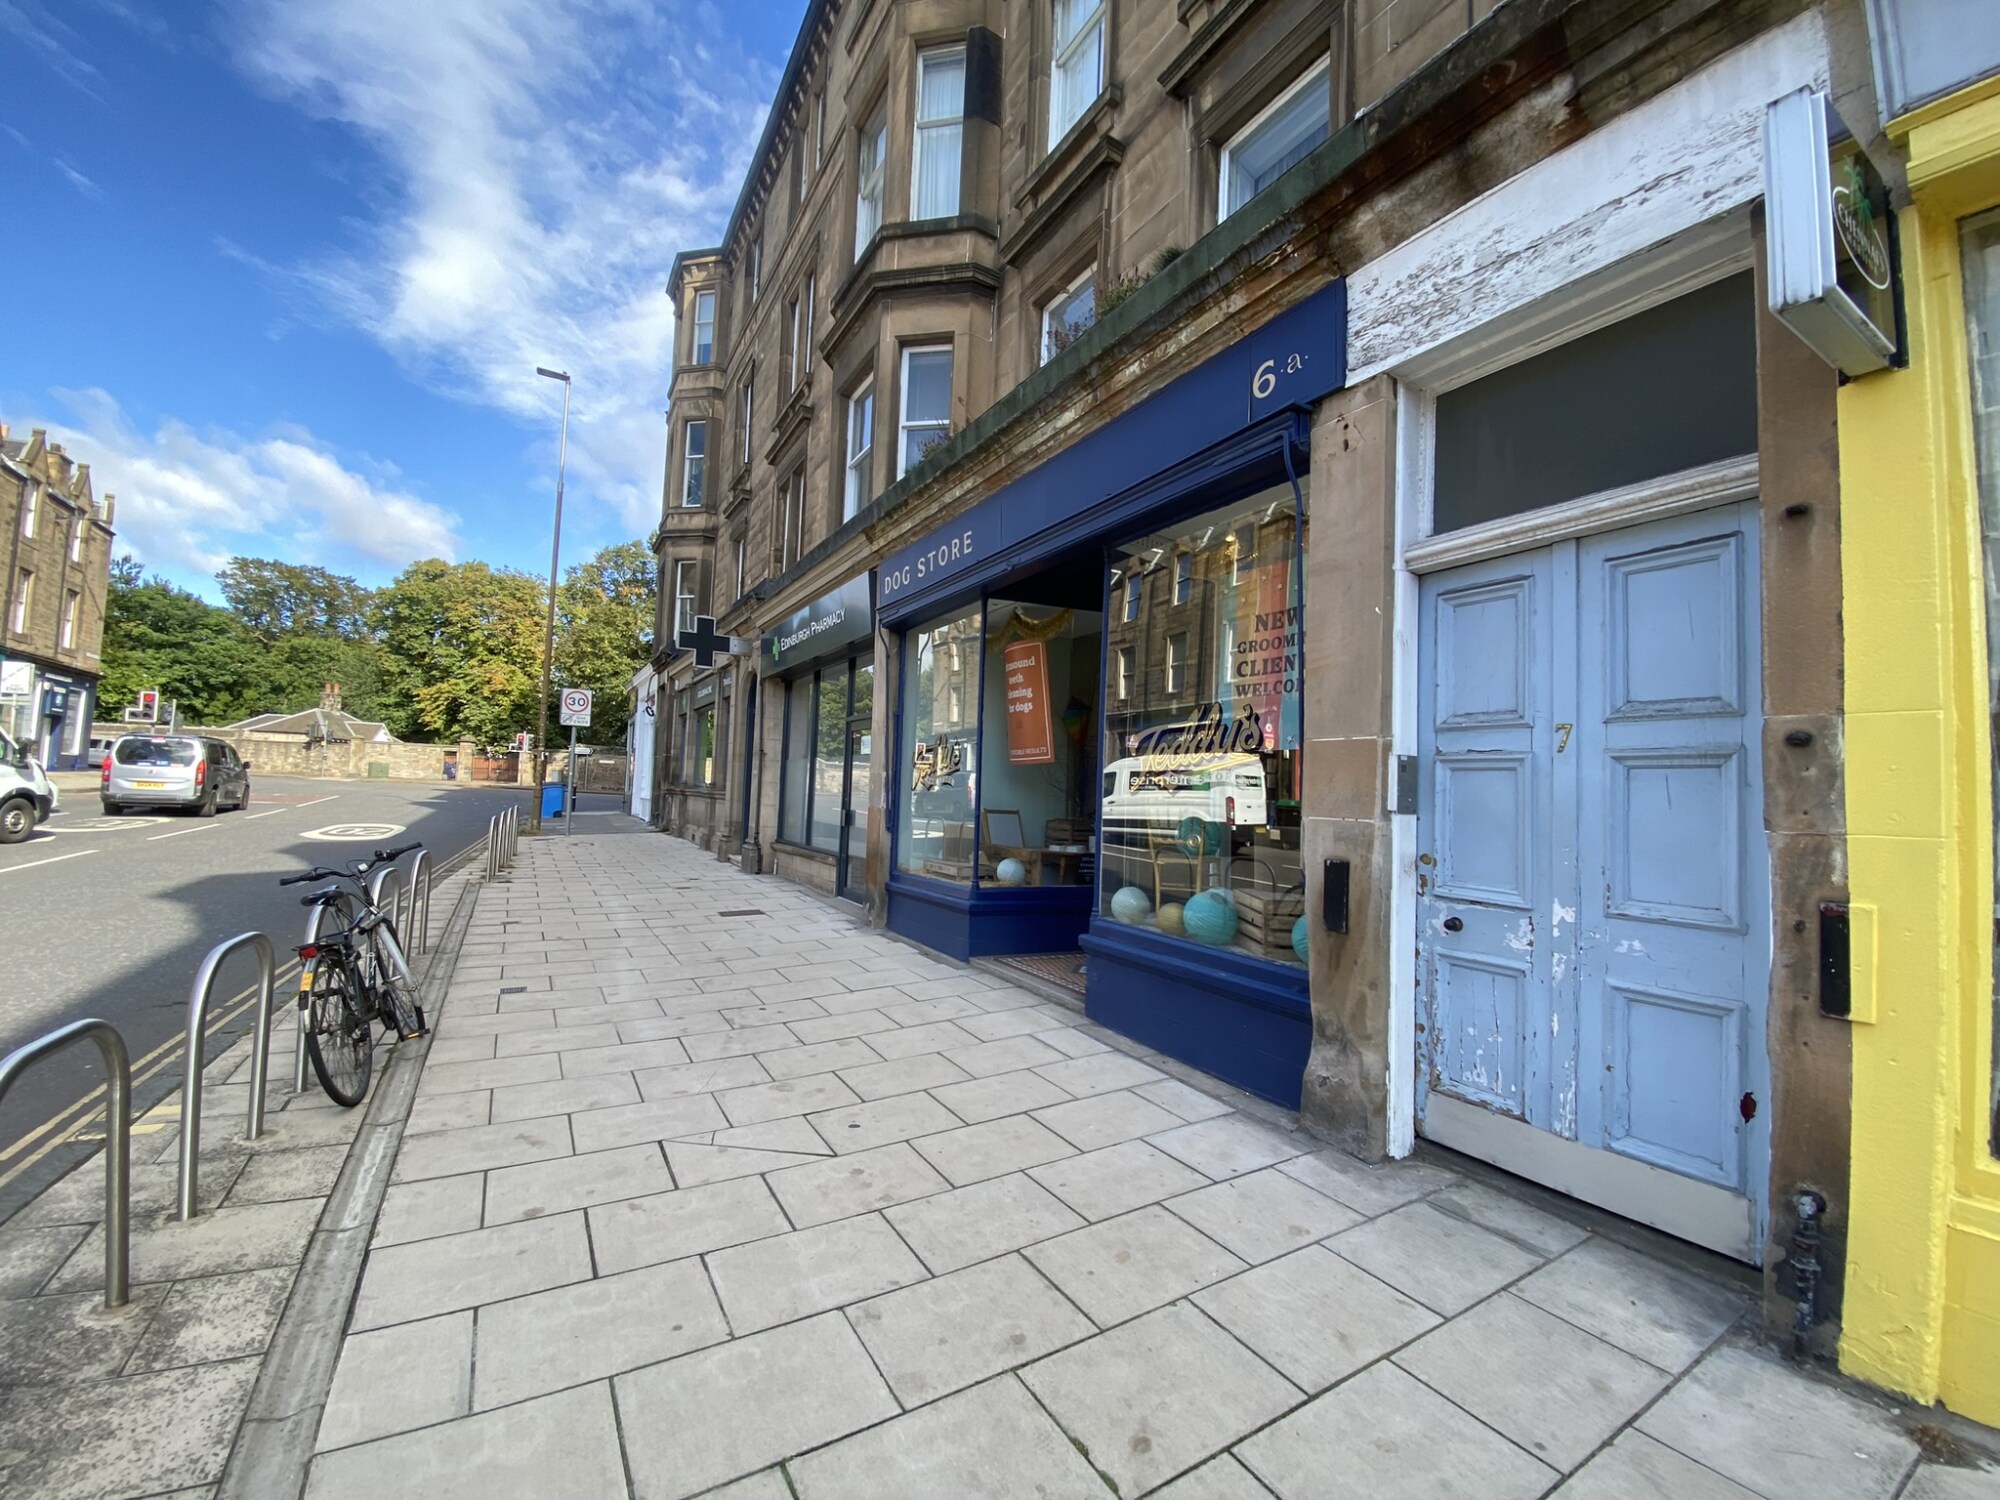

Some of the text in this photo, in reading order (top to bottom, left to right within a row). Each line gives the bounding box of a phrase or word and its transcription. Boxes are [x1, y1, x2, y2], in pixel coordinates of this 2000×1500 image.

[885, 531, 973, 594] DOG STORE
[1236, 654, 1297, 678] CLIEN
[568, 697, 586, 707] 30
[1015, 702, 1033, 713] dogs
[1128, 701, 1265, 792] Teddy's
[1555, 723, 1573, 753] 7
